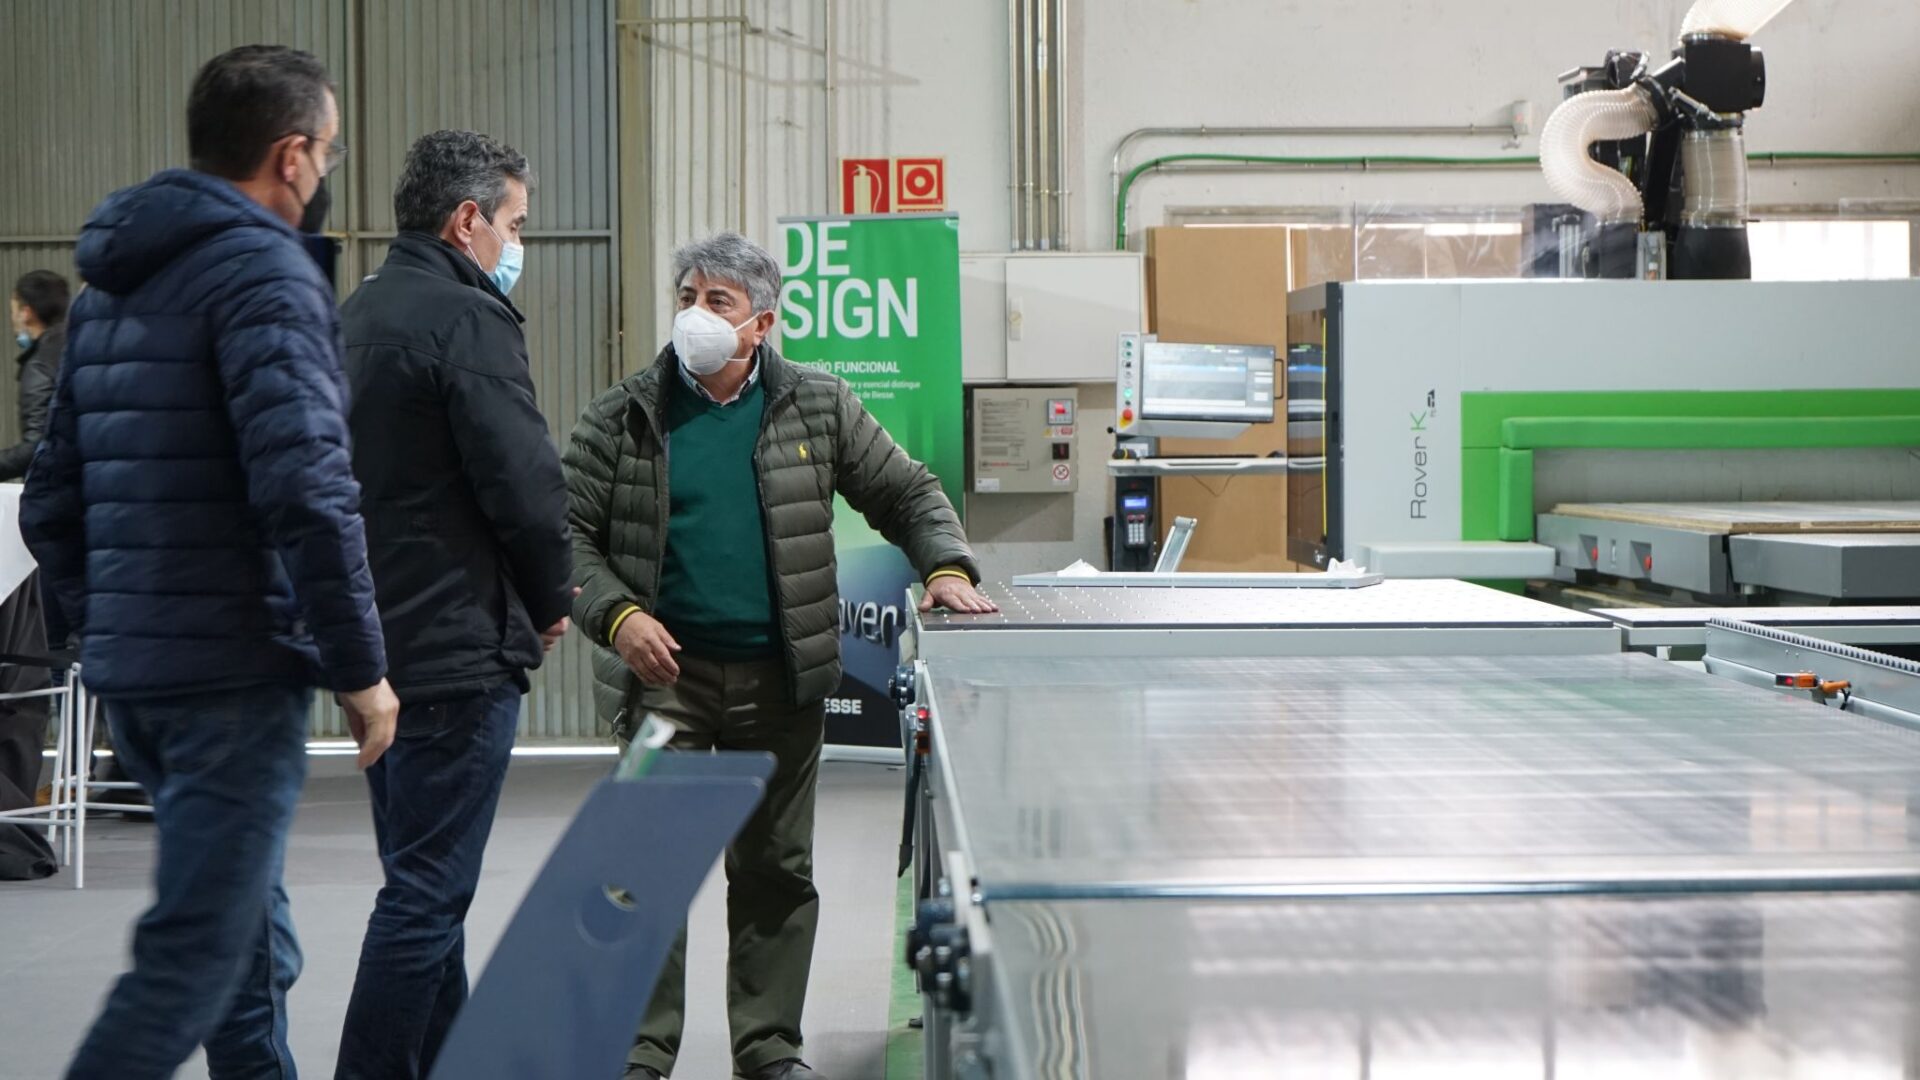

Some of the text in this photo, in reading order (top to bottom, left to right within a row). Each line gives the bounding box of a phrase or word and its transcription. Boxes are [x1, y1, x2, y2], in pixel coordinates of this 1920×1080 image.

[777, 221, 850, 277] DE
[781, 277, 918, 339] SIGN
[834, 361, 899, 373] FUNCIONAL
[1410, 411, 1427, 519] Rover K
